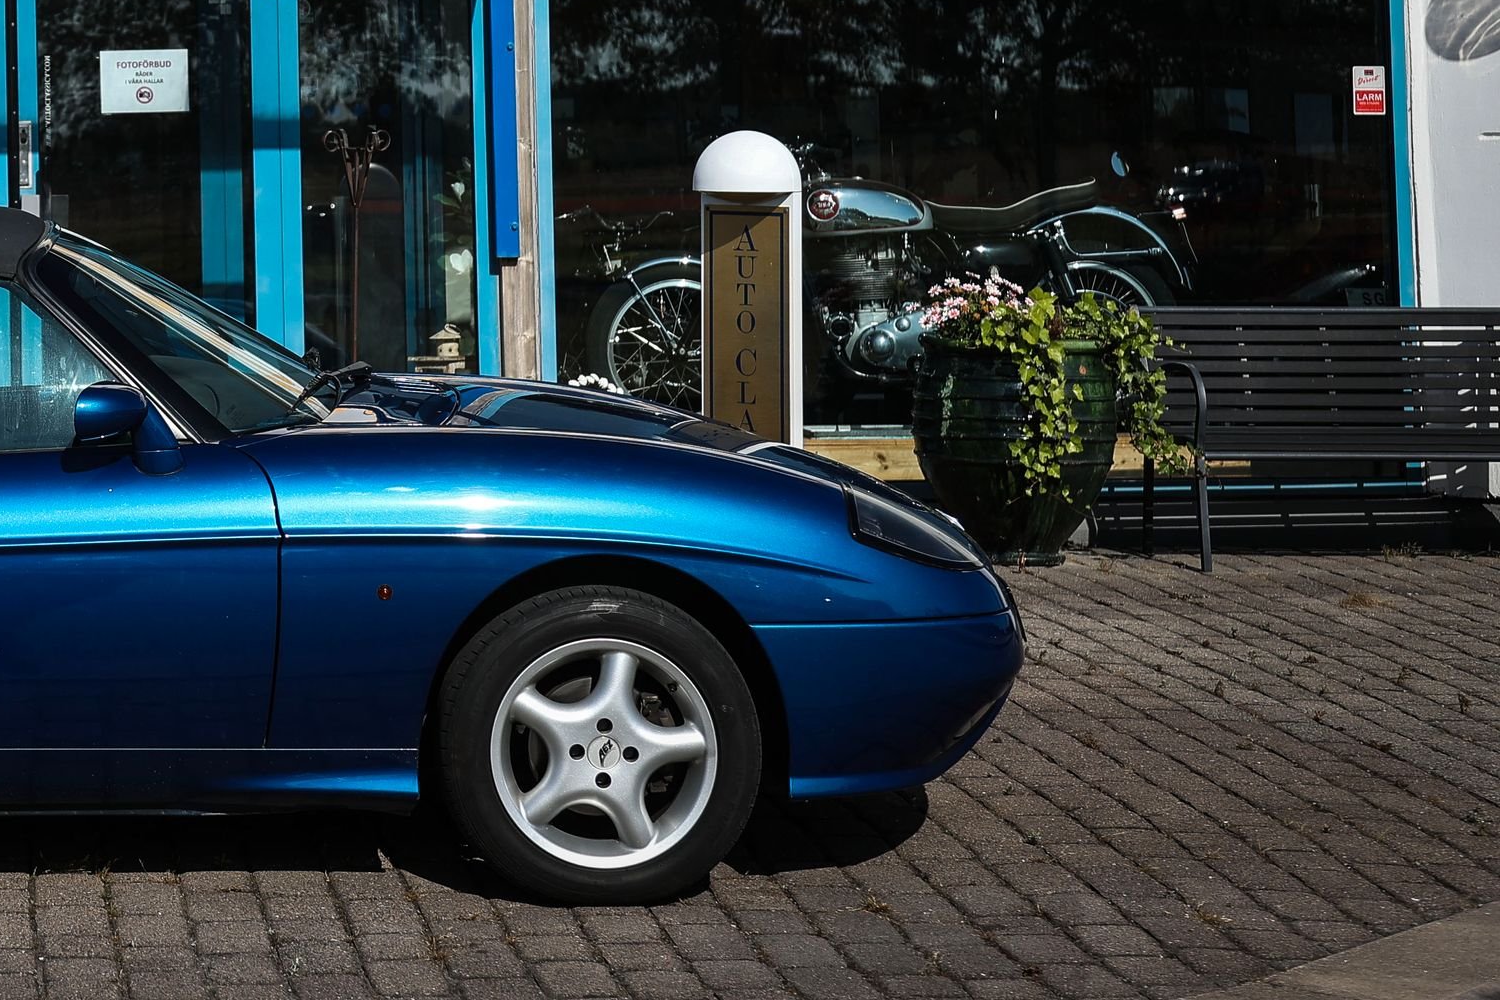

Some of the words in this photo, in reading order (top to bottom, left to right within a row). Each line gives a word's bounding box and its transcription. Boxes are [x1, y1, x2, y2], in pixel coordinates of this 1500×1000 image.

[116, 60, 172, 69] FOTOFÖRBUD
[1356, 93, 1382, 102] LARM
[732, 224, 759, 335] AUTO
